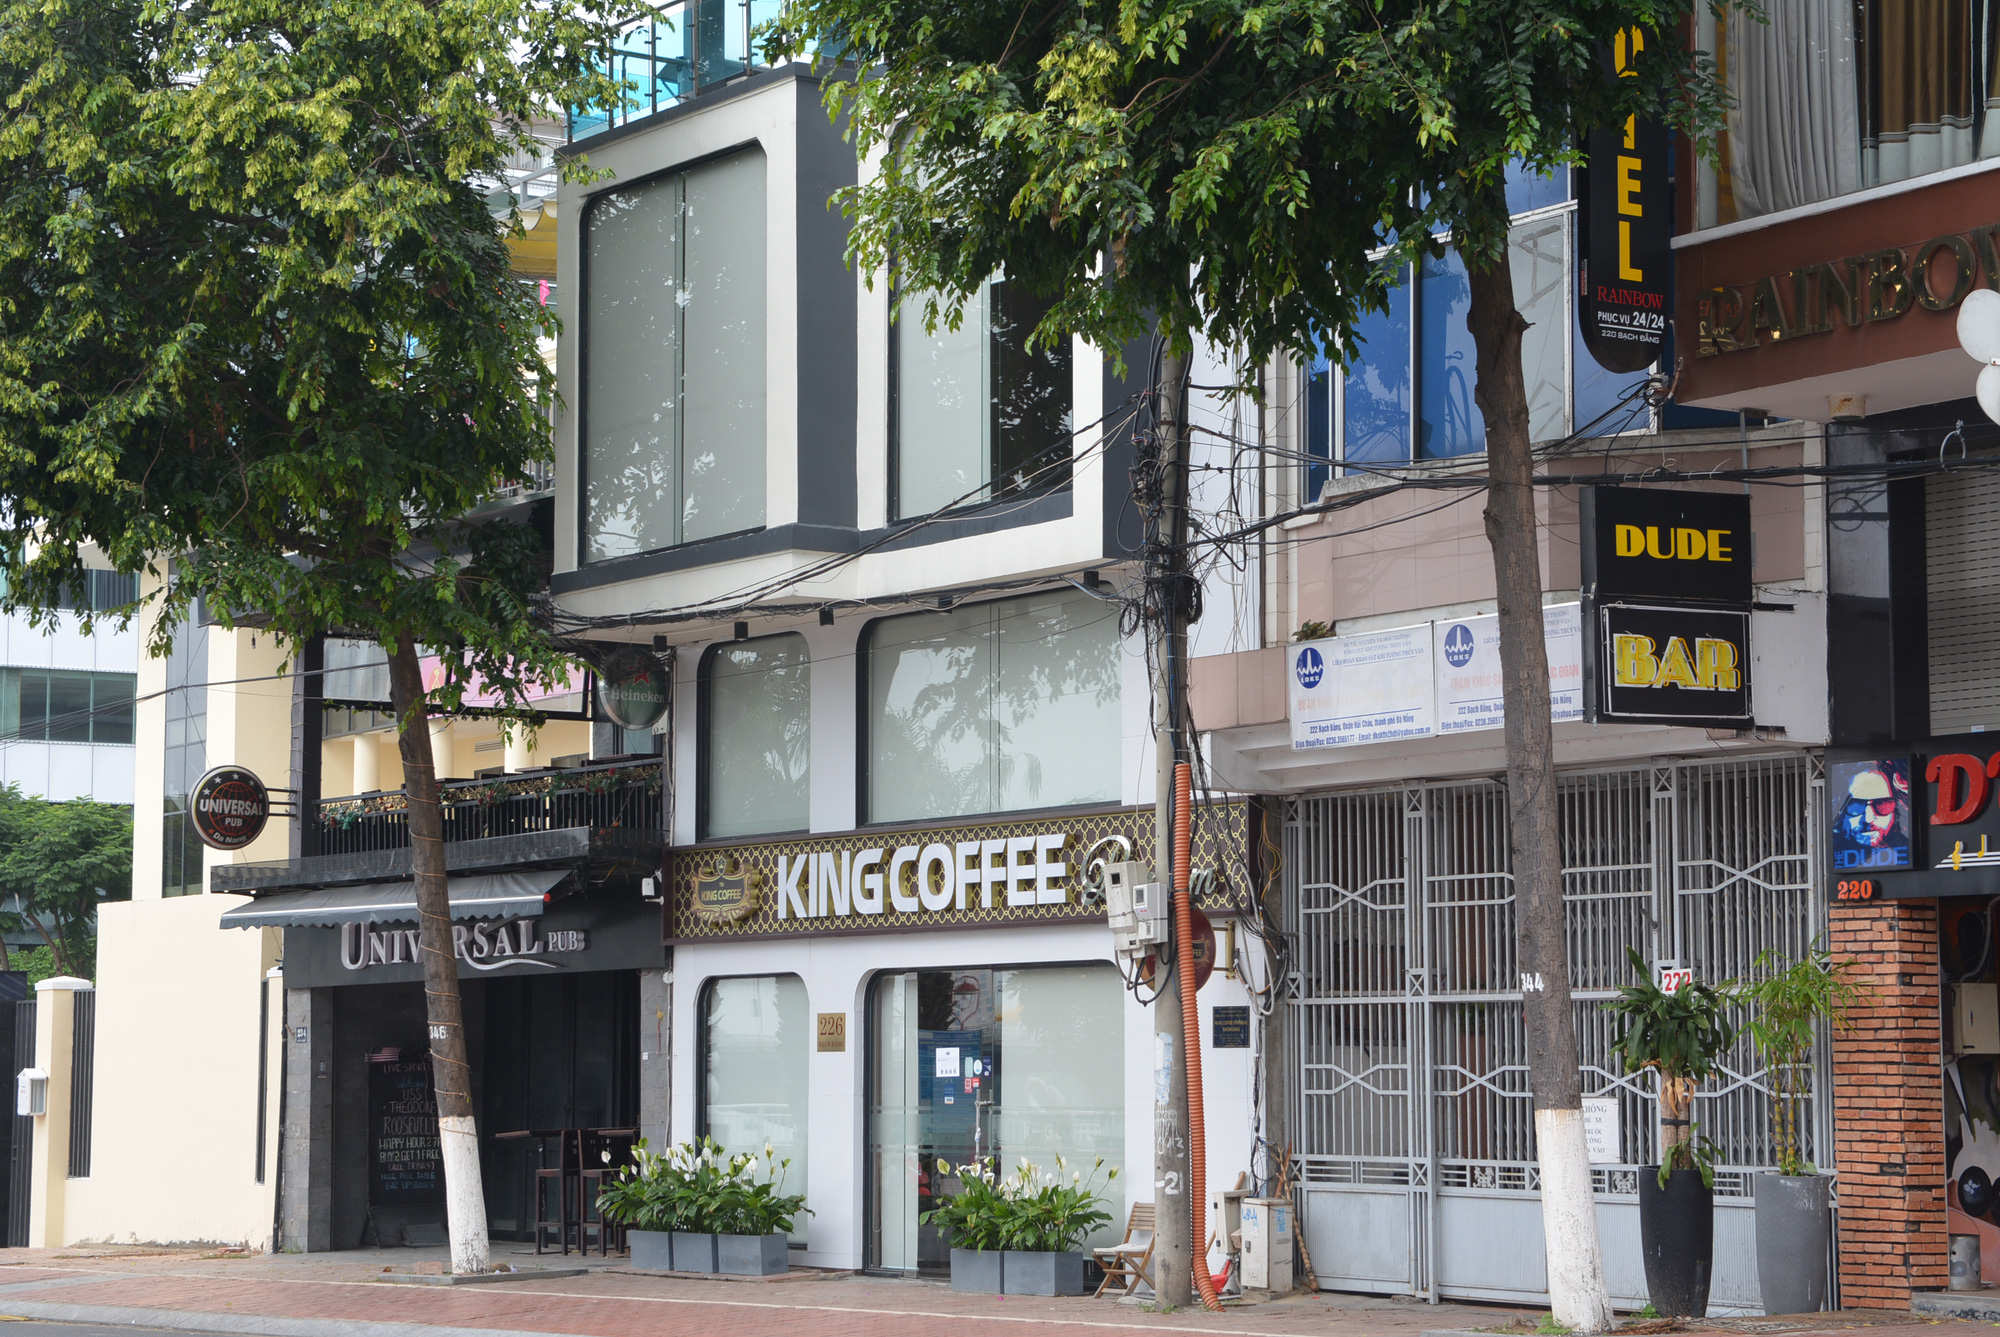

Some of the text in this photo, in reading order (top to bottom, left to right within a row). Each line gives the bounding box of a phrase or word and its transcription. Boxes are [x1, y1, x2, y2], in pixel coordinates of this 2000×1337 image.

[1597, 286, 1664, 309] RAINBOW
[1597, 311, 1665, 329] PHỤC VỤ 24/24
[1601, 330, 1617, 338] 220
[1618, 332, 1639, 341] BẠCH
[1615, 524, 1733, 562] DUDE
[1449, 653, 1470, 662] LOKS
[1612, 633, 1741, 692] BAR
[1300, 675, 1320, 684] LOKS
[610, 689, 665, 704] Heineken
[1458, 706, 1467, 715] 222
[1467, 704, 1479, 715] Bạch
[1309, 725, 1318, 734] 222
[1318, 723, 1330, 735] Bạch
[199, 798, 264, 816] UNIVERSAL
[225, 817, 243, 827] PUB
[212, 831, 247, 844] Da Nang
[1834, 850, 1844, 870] THE
[1843, 846, 1909, 868] DUDE
[701, 888, 742, 902] KING COFFEE
[1837, 879, 1872, 900] 220
[341, 919, 582, 970] UNIVRSAL PUB
[819, 1016, 844, 1036] 226
[389, 1100, 436, 1115] THEODORE
[383, 1116, 437, 1135] ROOSEVELT
[378, 1138, 405, 1150] HAPPY
[406, 1136, 426, 1149] HOUR
[394, 1150, 400, 1161] 2
[401, 1149, 415, 1161] GET
[416, 1150, 421, 1160] 1
[421, 1148, 440, 1160] FREE
